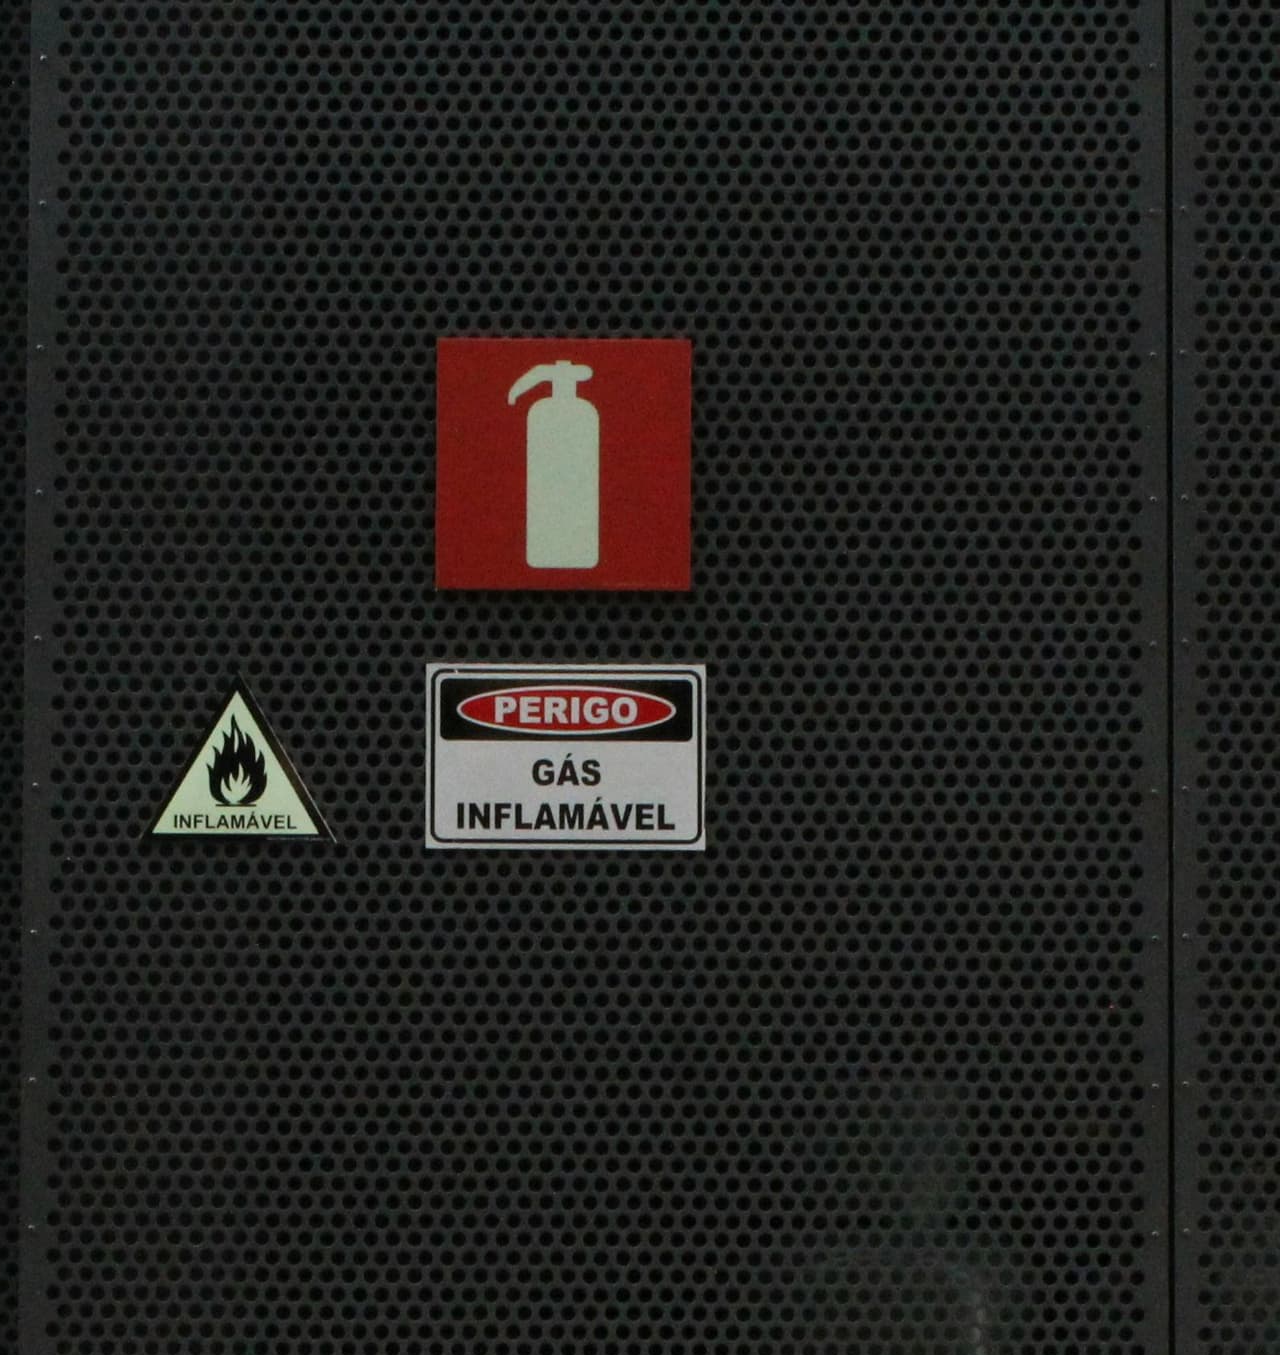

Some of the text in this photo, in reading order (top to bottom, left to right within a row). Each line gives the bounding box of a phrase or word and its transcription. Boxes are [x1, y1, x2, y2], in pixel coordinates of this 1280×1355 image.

[493, 695, 639, 725] PERIGO
[531, 752, 602, 787] GÁS
[173, 811, 297, 830] INFLAMÁVEL
[456, 796, 676, 831] INFLAMÁVEL
